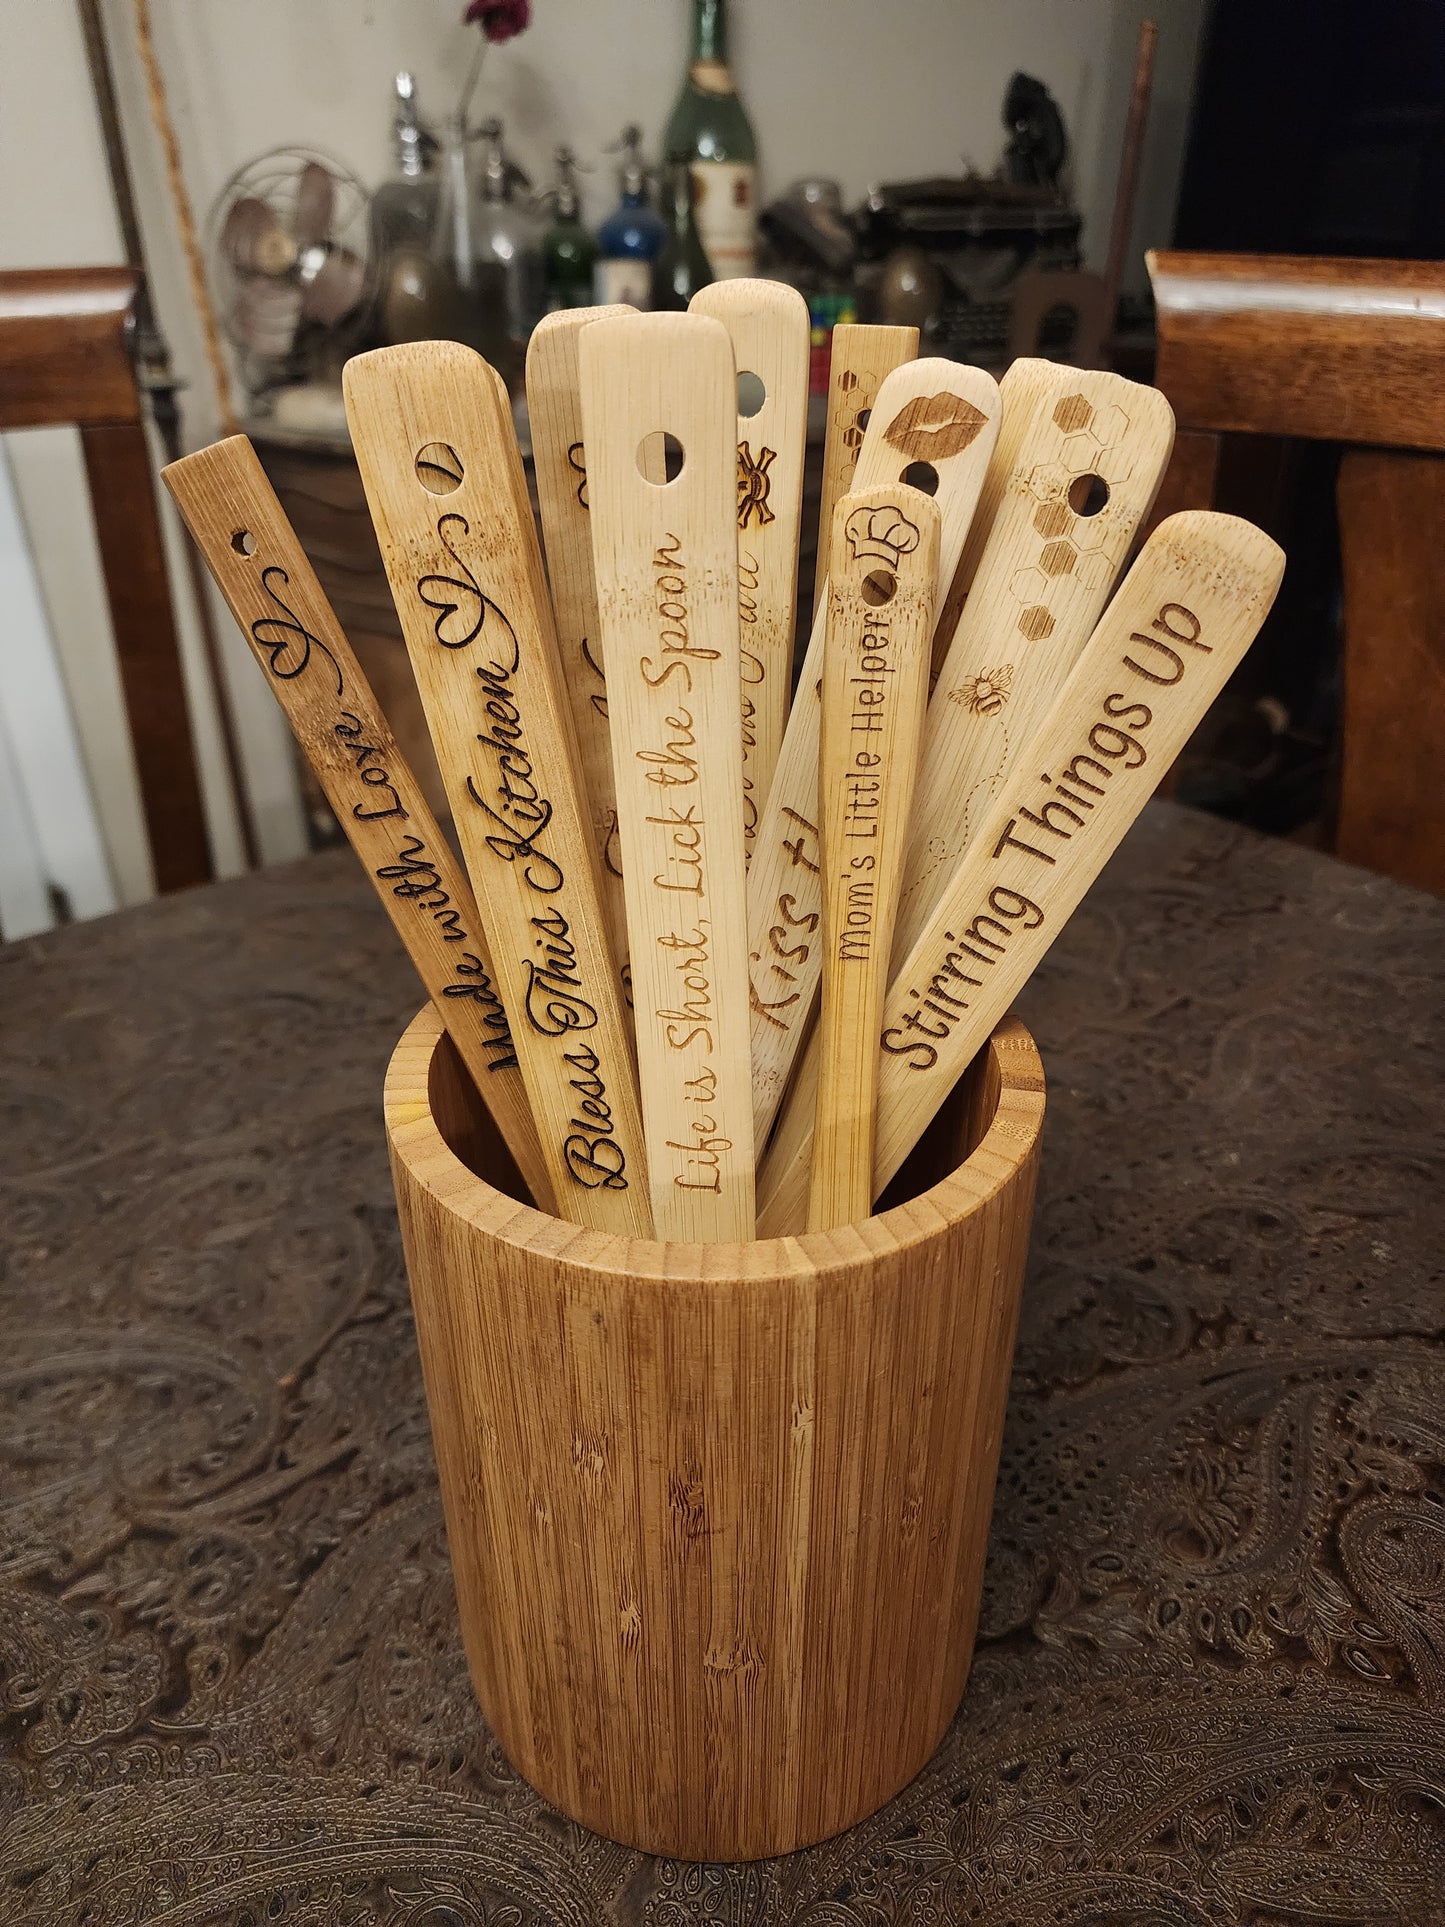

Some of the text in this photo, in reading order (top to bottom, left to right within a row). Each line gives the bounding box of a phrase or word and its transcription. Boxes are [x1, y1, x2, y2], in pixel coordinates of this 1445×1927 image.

[849, 612, 896, 732] Helper
[335, 711, 409, 822] Love
[466, 658, 566, 895] Kitchen
[845, 751, 882, 838] Little
[376, 834, 468, 943] with
[635, 531, 734, 1195] Life is Short, Lick the Spoon
[879, 601, 1215, 1072] Stirring Things Up
[522, 905, 599, 1038] This
[564, 1042, 629, 1192] Bless
